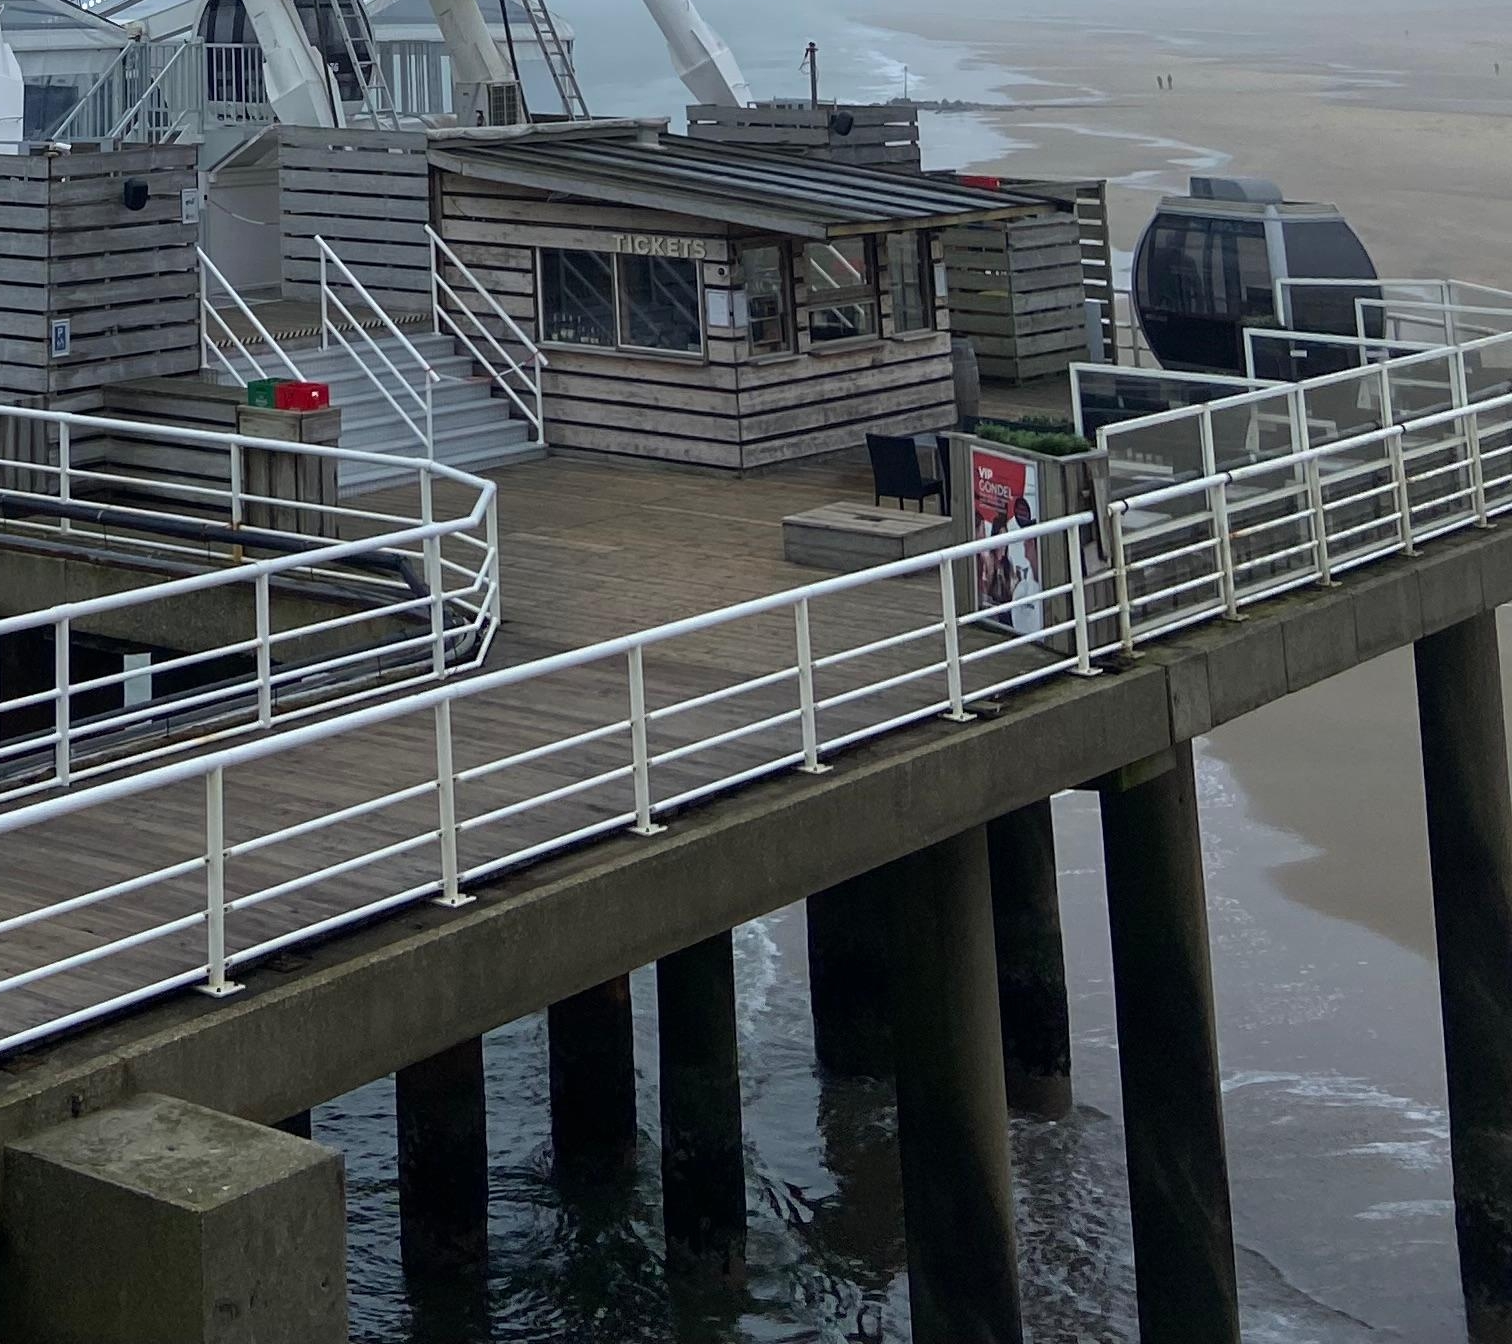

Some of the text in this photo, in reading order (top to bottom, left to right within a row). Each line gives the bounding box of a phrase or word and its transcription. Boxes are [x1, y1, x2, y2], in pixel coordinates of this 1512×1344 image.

[612, 234, 706, 259] TICKETS
[978, 465, 993, 480] VIP
[978, 479, 1012, 499] GONDEL
